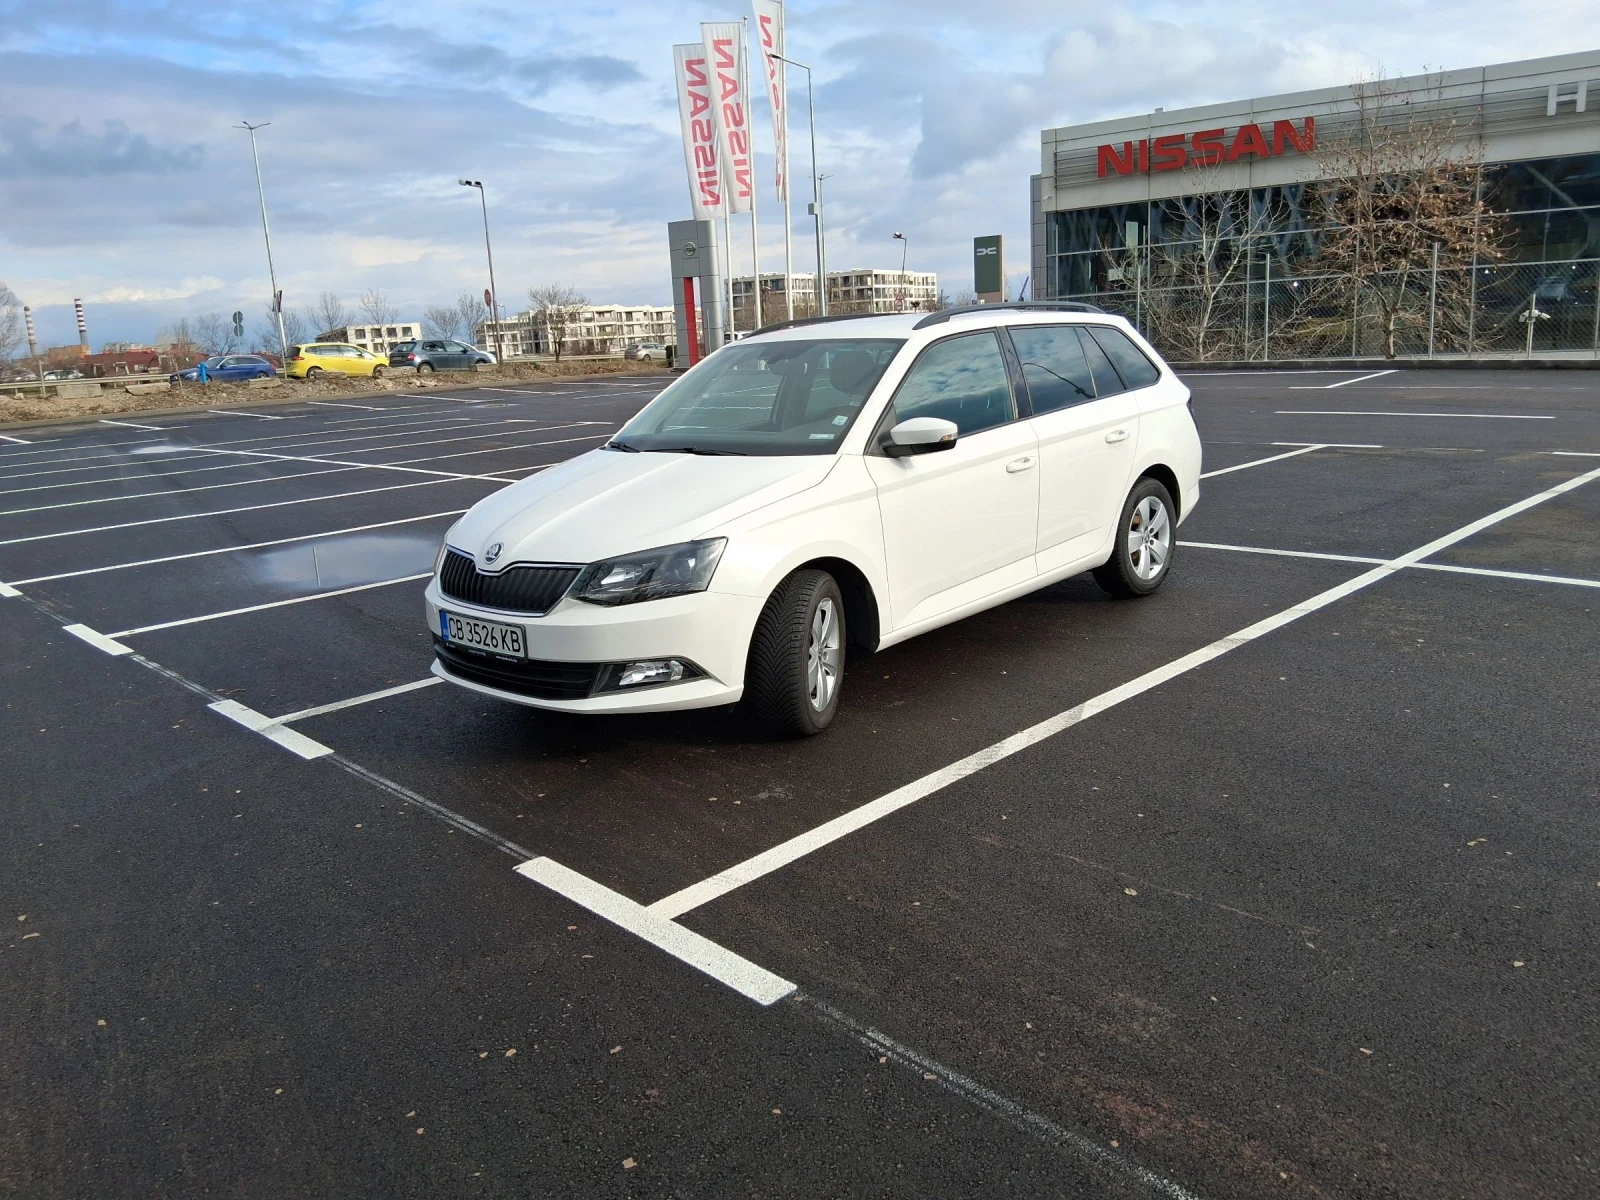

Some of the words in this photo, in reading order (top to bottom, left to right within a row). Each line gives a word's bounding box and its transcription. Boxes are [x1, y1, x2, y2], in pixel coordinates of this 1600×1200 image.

[1097, 116, 1315, 178] NISSAN
[448, 617, 465, 641] CB
[466, 621, 499, 649] 3526
[500, 627, 521, 653] KB
